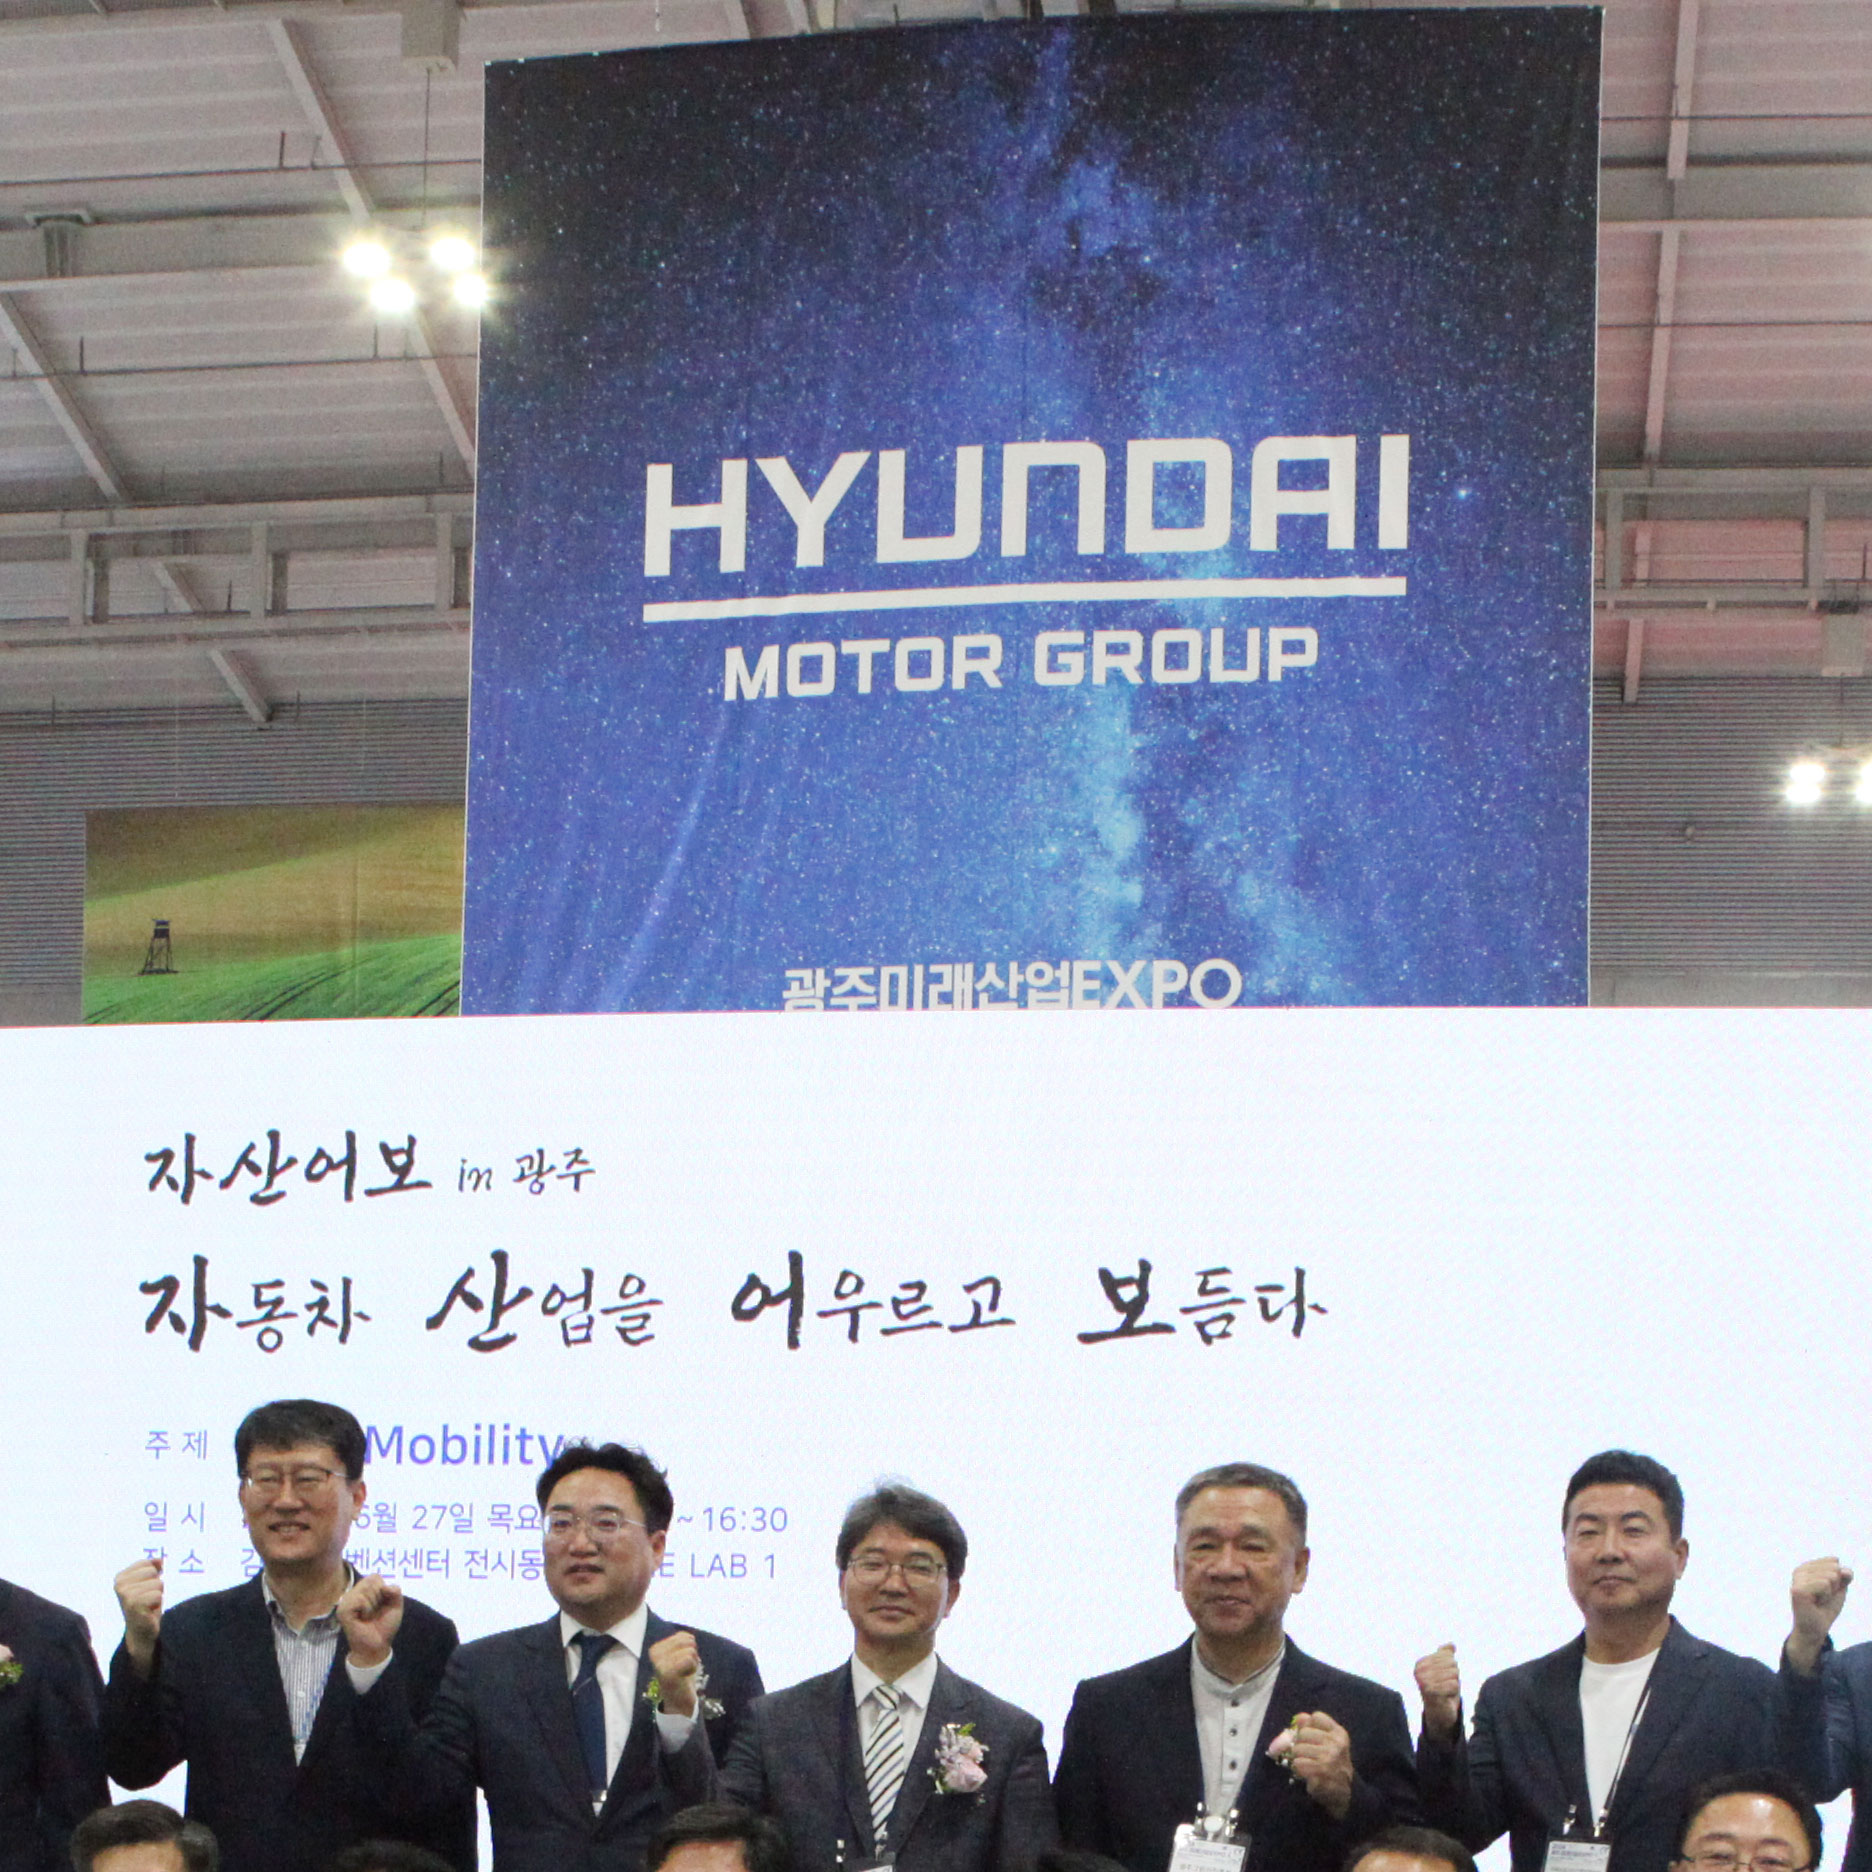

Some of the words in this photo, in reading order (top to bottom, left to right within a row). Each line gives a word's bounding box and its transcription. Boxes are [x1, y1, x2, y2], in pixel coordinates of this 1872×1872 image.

[643, 434, 1410, 578] HYUNDAI
[723, 636, 1003, 701] MOTOR
[1034, 627, 1319, 686] GROUP
[145, 1129, 433, 1206] 자산어보
[458, 1158, 492, 1193] in
[513, 1147, 596, 1195] 광주
[139, 1253, 372, 1353] 자동차
[425, 1248, 664, 1353] 산업을
[731, 1250, 1016, 1350] 어우르고
[1077, 1258, 1328, 1346] 보듬다
[412, 1503, 474, 1533] 27일
[487, 1502, 542, 1533] 목요
[690, 1552, 747, 1578] LAB
[764, 1552, 775, 1579] 1
